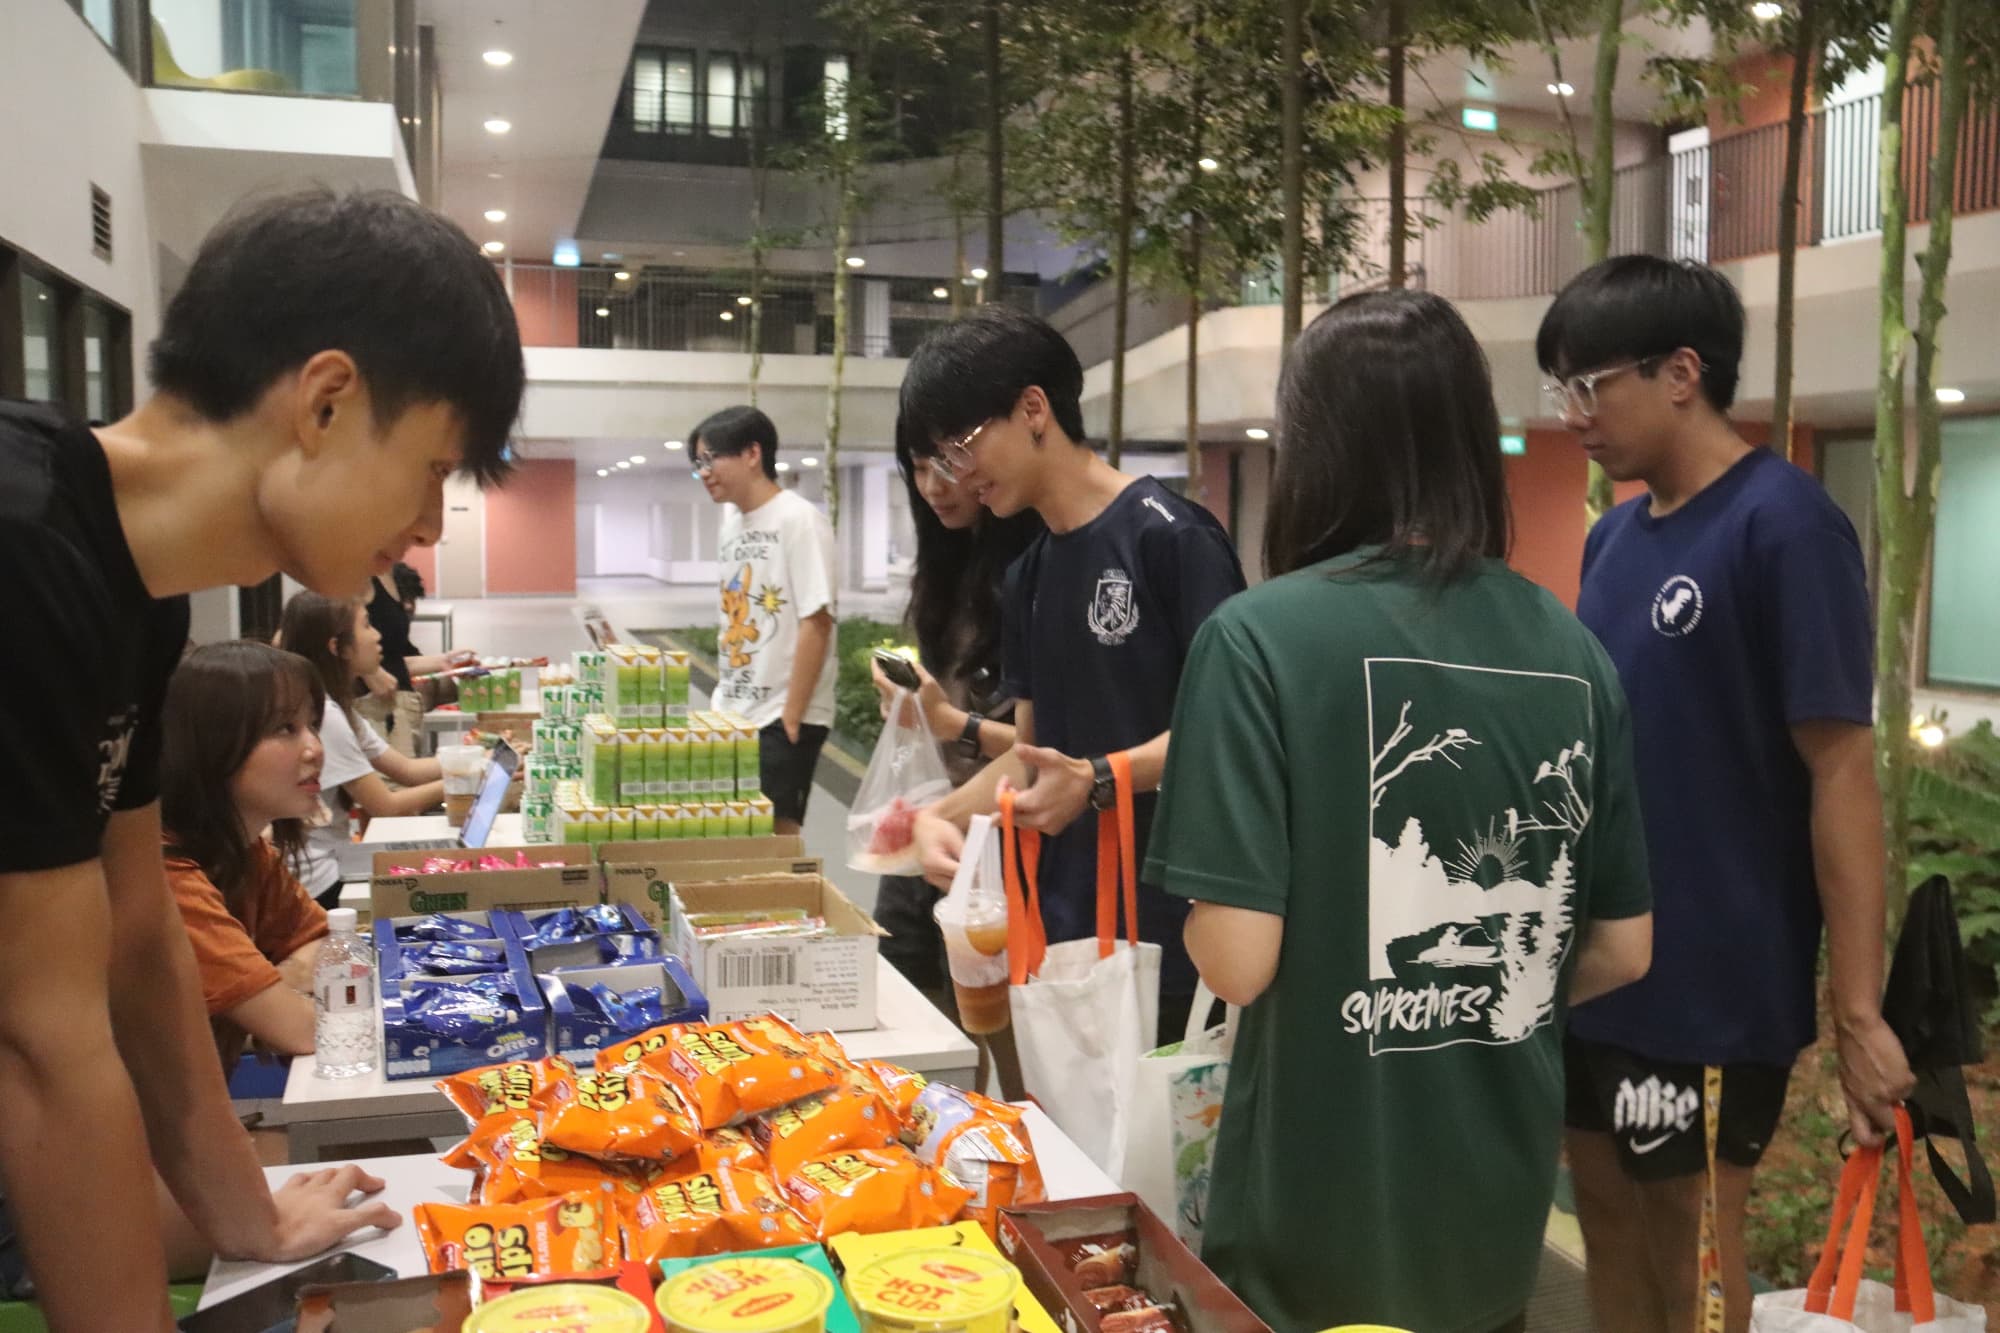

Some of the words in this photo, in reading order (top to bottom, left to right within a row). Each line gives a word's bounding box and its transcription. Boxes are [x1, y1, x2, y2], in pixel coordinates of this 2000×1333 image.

[1341, 982, 1492, 1036] SUPREMES
[885, 1277, 955, 1299] HOT
[876, 1290, 941, 1311] CUP
